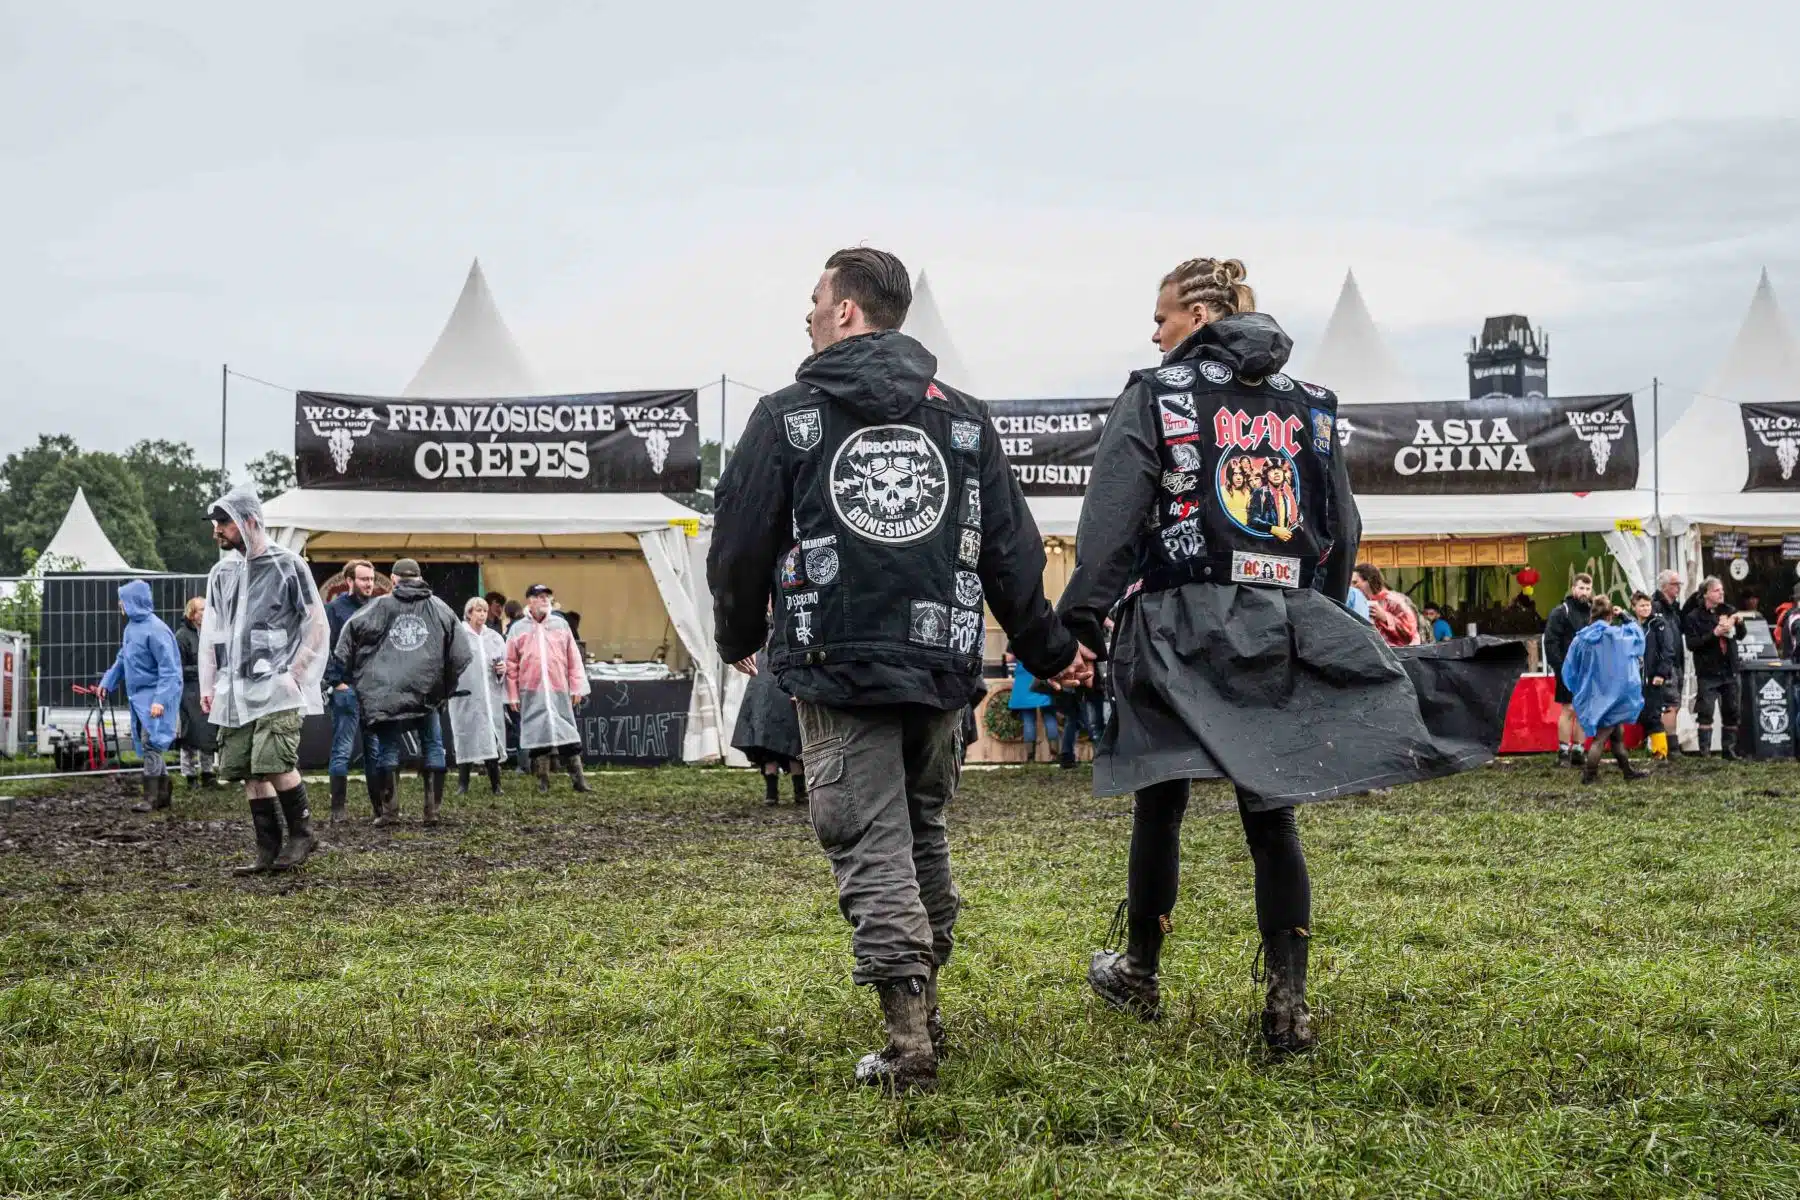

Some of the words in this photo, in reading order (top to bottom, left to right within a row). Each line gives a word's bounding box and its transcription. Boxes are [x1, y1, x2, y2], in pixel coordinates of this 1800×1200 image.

[386, 402, 615, 433] FRANZÖSISCHE
[991, 413, 1092, 434] CHISCHE
[1412, 417, 1519, 446] ASIA
[414, 433, 590, 480] CRÉPES
[1394, 444, 1536, 476] CHINA
[846, 505, 938, 537] BONESHAKER
[1163, 534, 1205, 560] POP
[949, 623, 977, 654] POP
[576, 712, 690, 758] ERZHAFT
